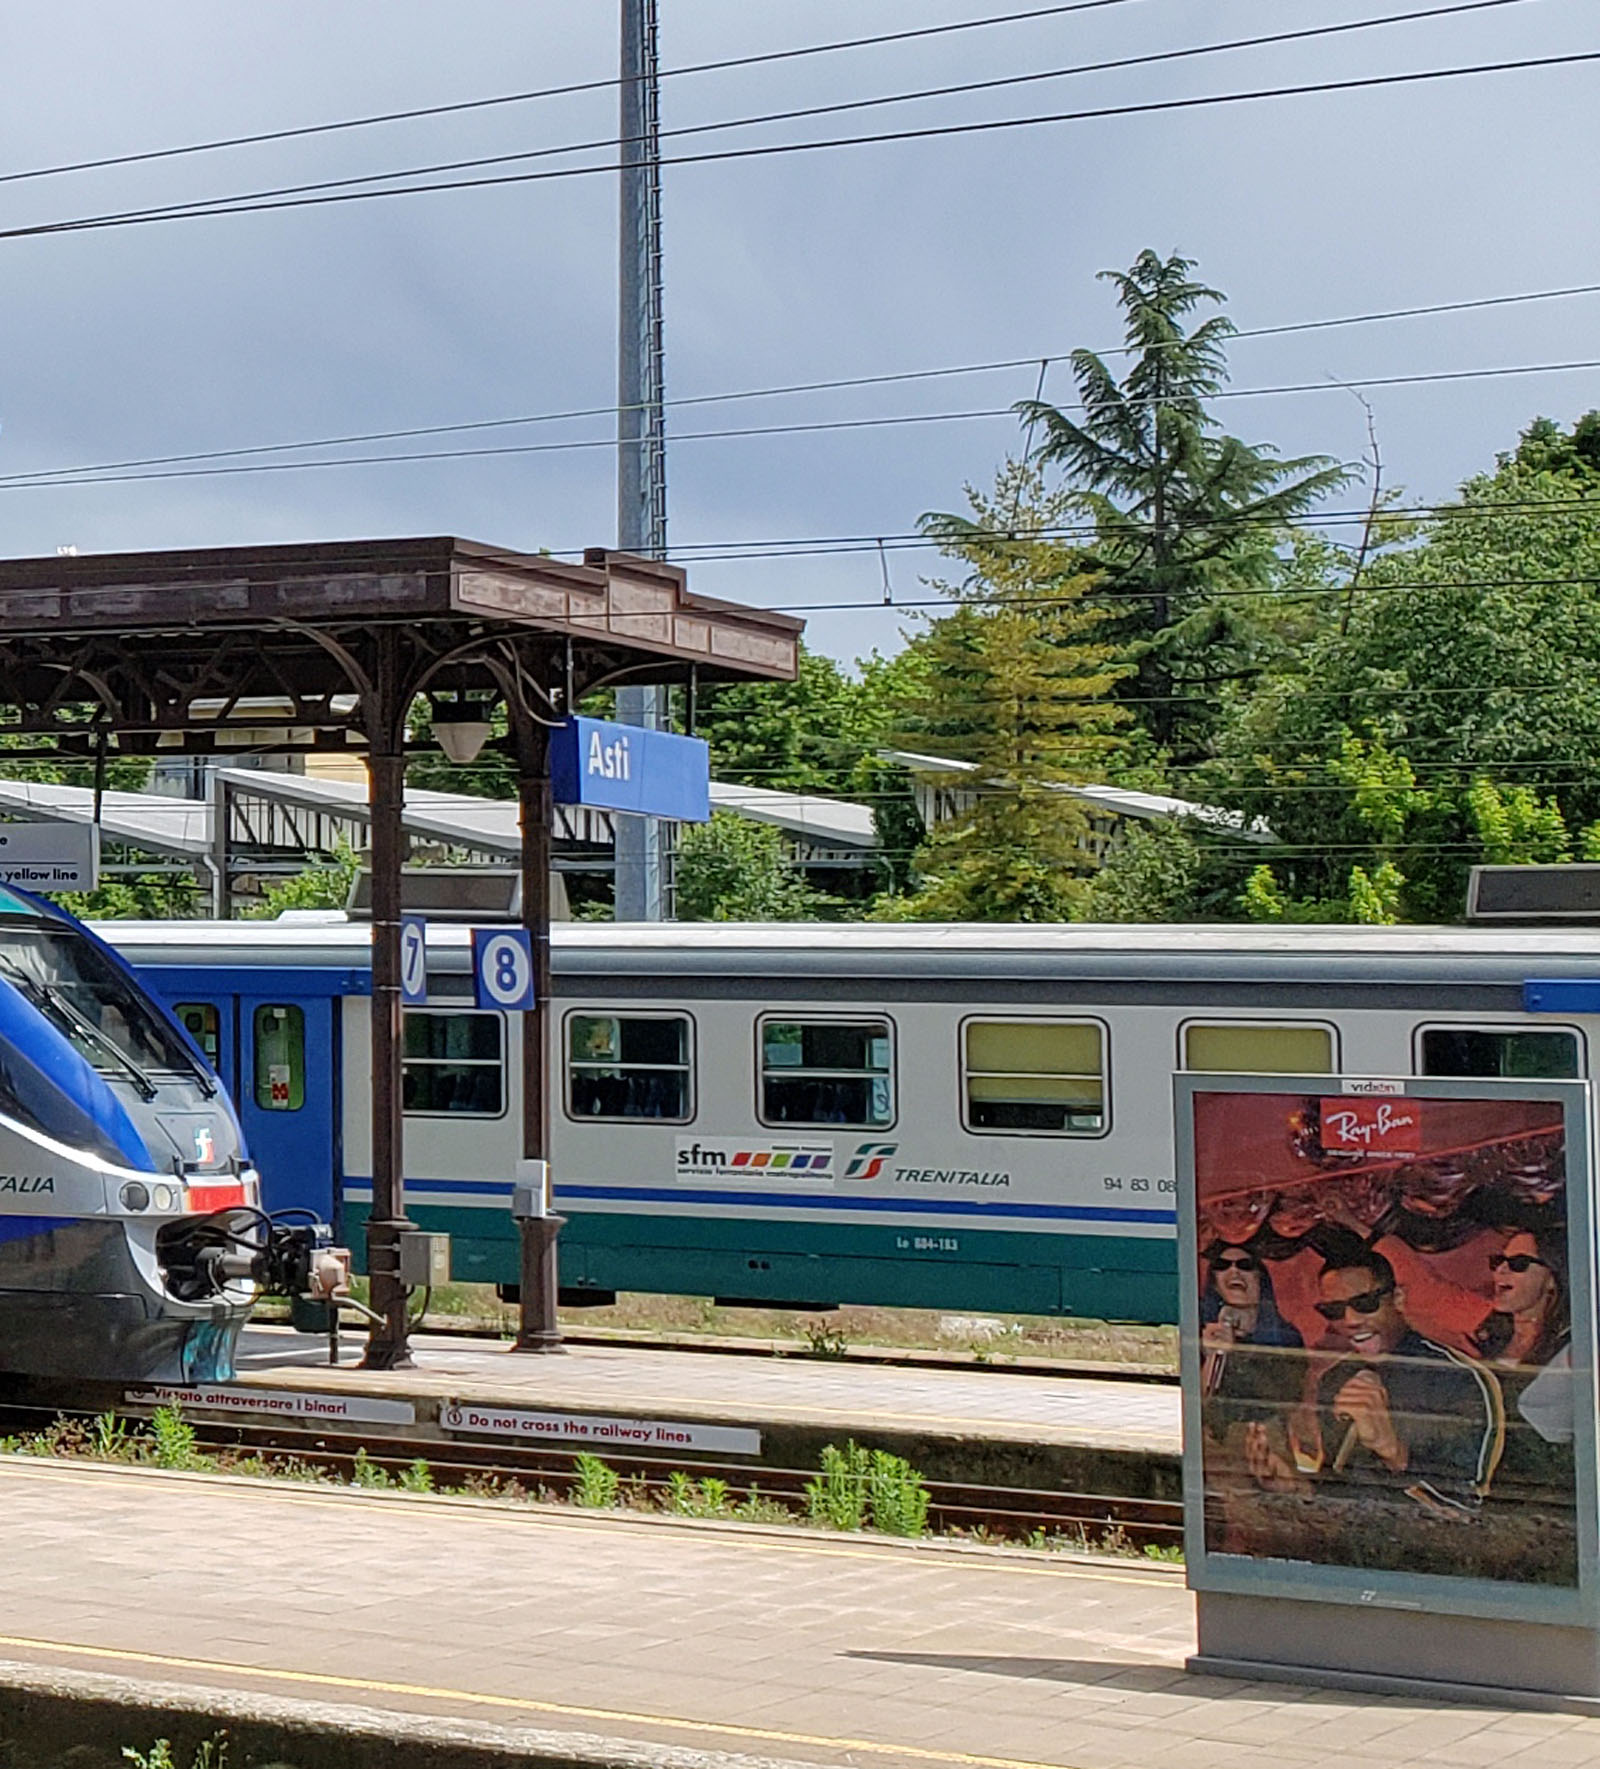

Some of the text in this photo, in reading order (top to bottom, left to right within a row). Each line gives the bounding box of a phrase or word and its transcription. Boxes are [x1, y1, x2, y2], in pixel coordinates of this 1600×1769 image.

[588, 731, 629, 781] Asti
[5, 869, 50, 883] yellow
[53, 869, 79, 881] line
[406, 935, 419, 981] 7
[496, 947, 517, 992] 8
[1325, 1104, 1414, 1144] Ray-Ban
[677, 1143, 726, 1167] sfm
[895, 1169, 1011, 1187] TRENITALIA
[1104, 1177, 1122, 1191] 94
[1131, 1178, 1150, 1192] 83
[206, 1392, 293, 1411] attraversare
[297, 1398, 301, 1411] i
[304, 1399, 347, 1415] binari
[469, 1413, 693, 1443] Do not cross the railway lines
